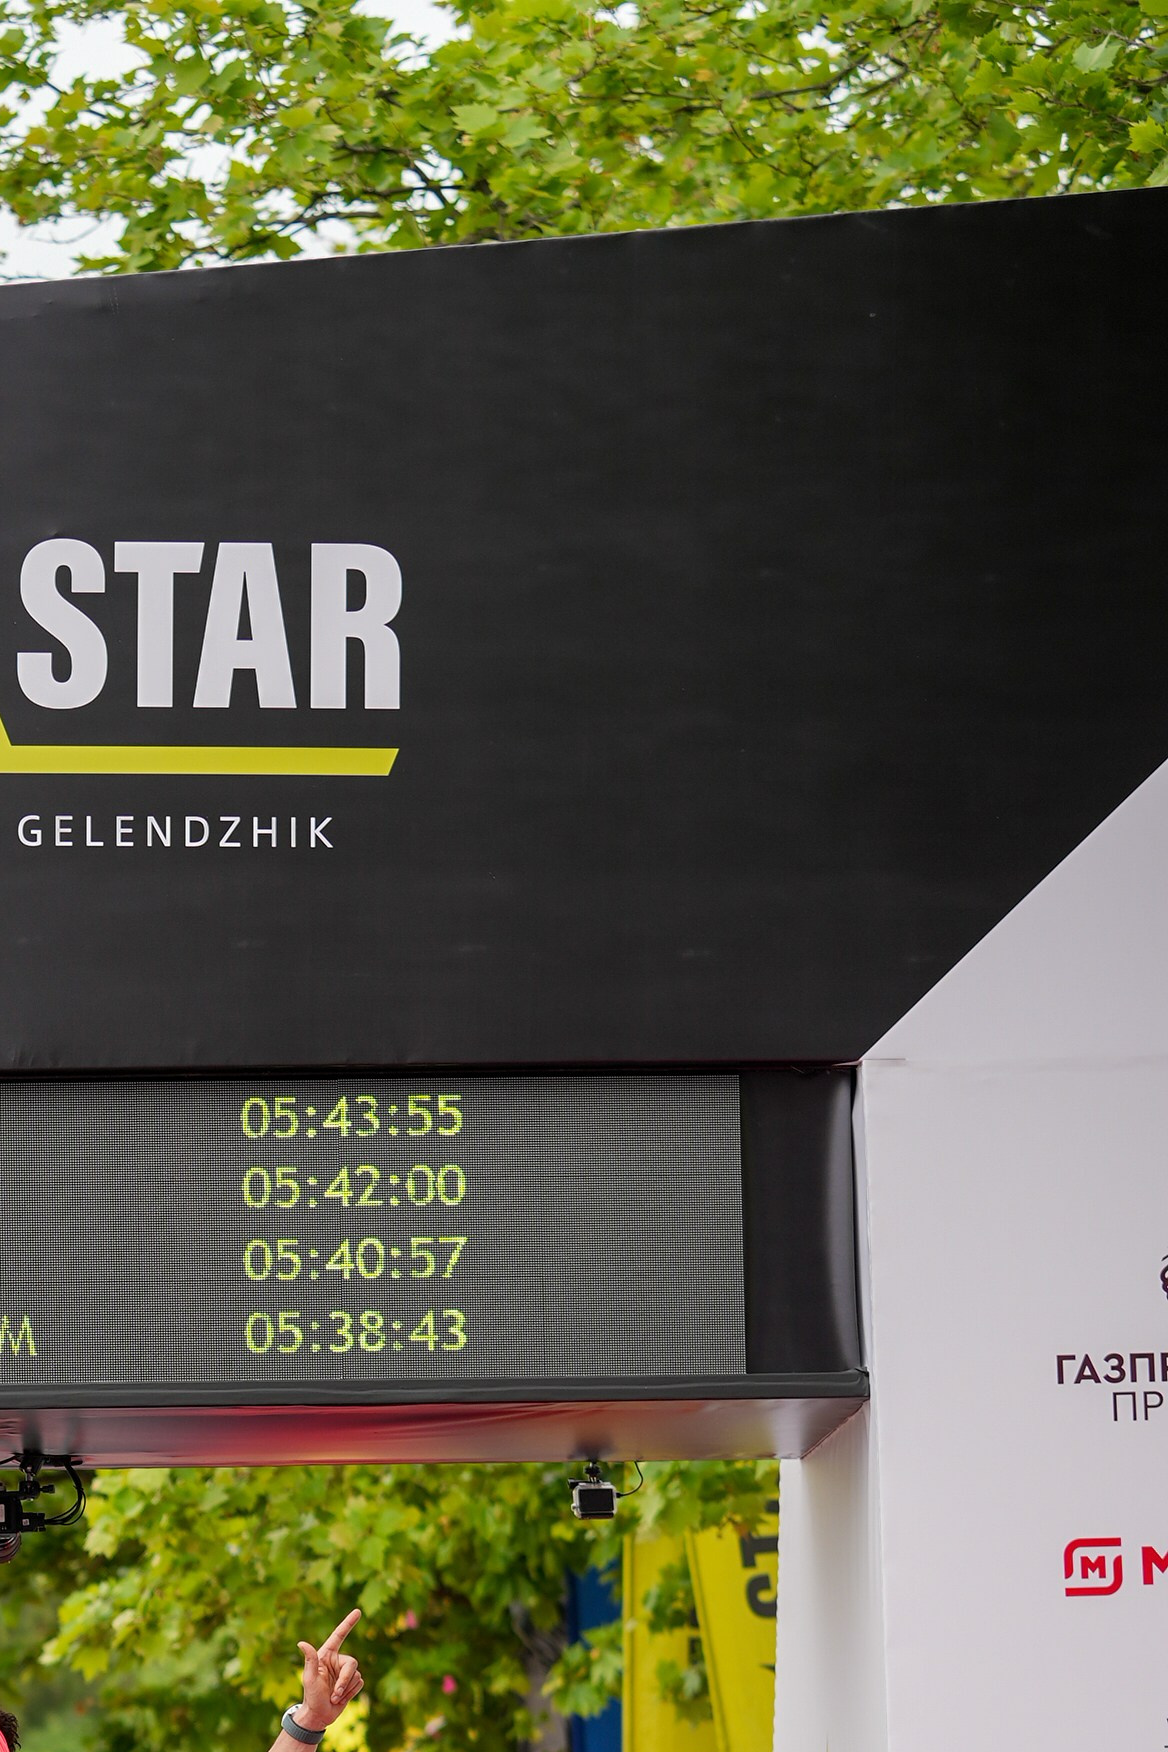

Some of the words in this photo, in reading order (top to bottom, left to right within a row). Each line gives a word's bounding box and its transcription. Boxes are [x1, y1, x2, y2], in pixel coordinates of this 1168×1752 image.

[16, 537, 404, 711] STAR
[16, 813, 334, 849] GELENDZHIK
[240, 1094, 464, 1138] 05:43:55
[241, 1164, 467, 1208] 05:42:00
[242, 1236, 468, 1281] 05:40:57
[244, 1308, 468, 1354] 05:38:43
[1056, 1352, 1168, 1385] ГАЗП
